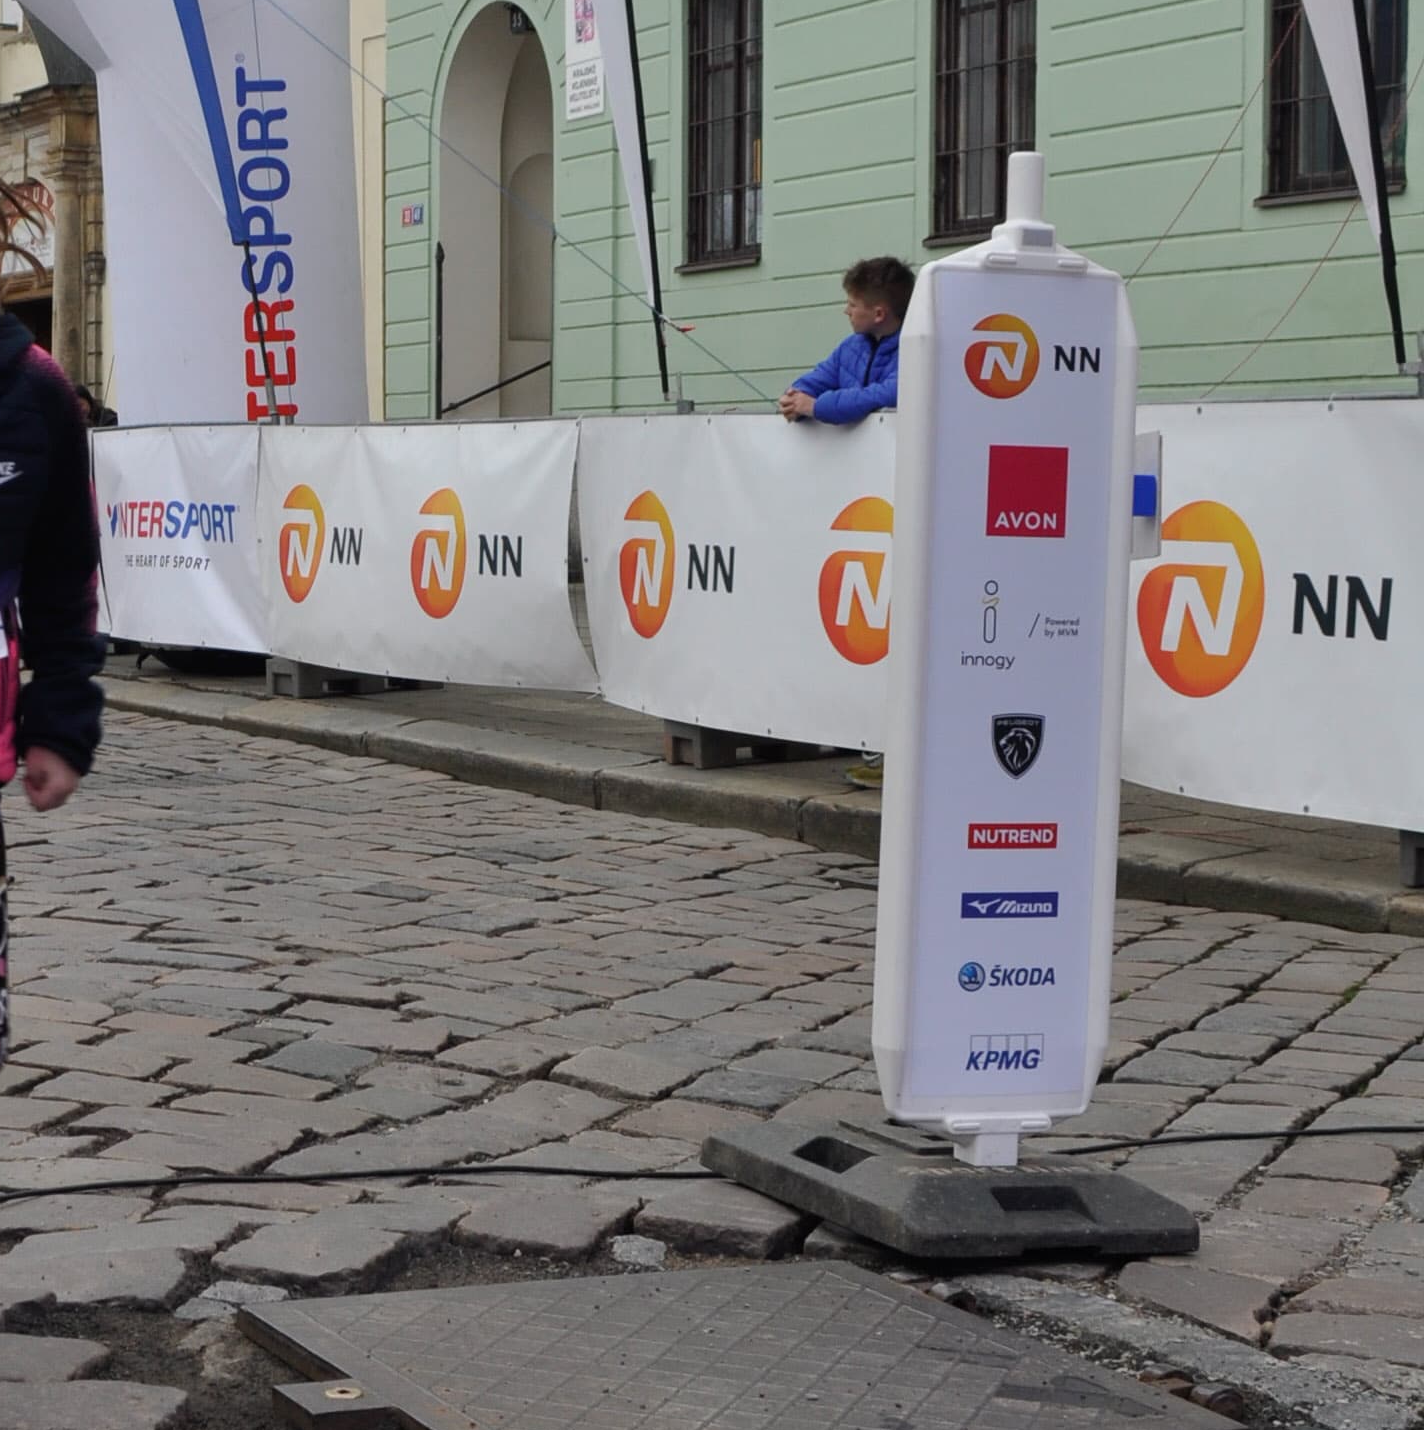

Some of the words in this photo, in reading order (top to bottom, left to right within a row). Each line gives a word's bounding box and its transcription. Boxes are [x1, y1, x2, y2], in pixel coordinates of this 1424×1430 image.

[1053, 345, 1100, 373] NN
[994, 512, 1057, 531] AVON
[331, 527, 363, 567] NN
[478, 534, 523, 578] NN
[160, 555, 170, 568] OF
[173, 555, 210, 571] SPORT
[687, 543, 736, 595] NN
[1292, 572, 1393, 641] NN
[961, 651, 1016, 670] innogy
[973, 828, 1054, 844] NUTREND
[988, 965, 1056, 988] ŠKODA
[966, 1048, 1041, 1071] KPMG
